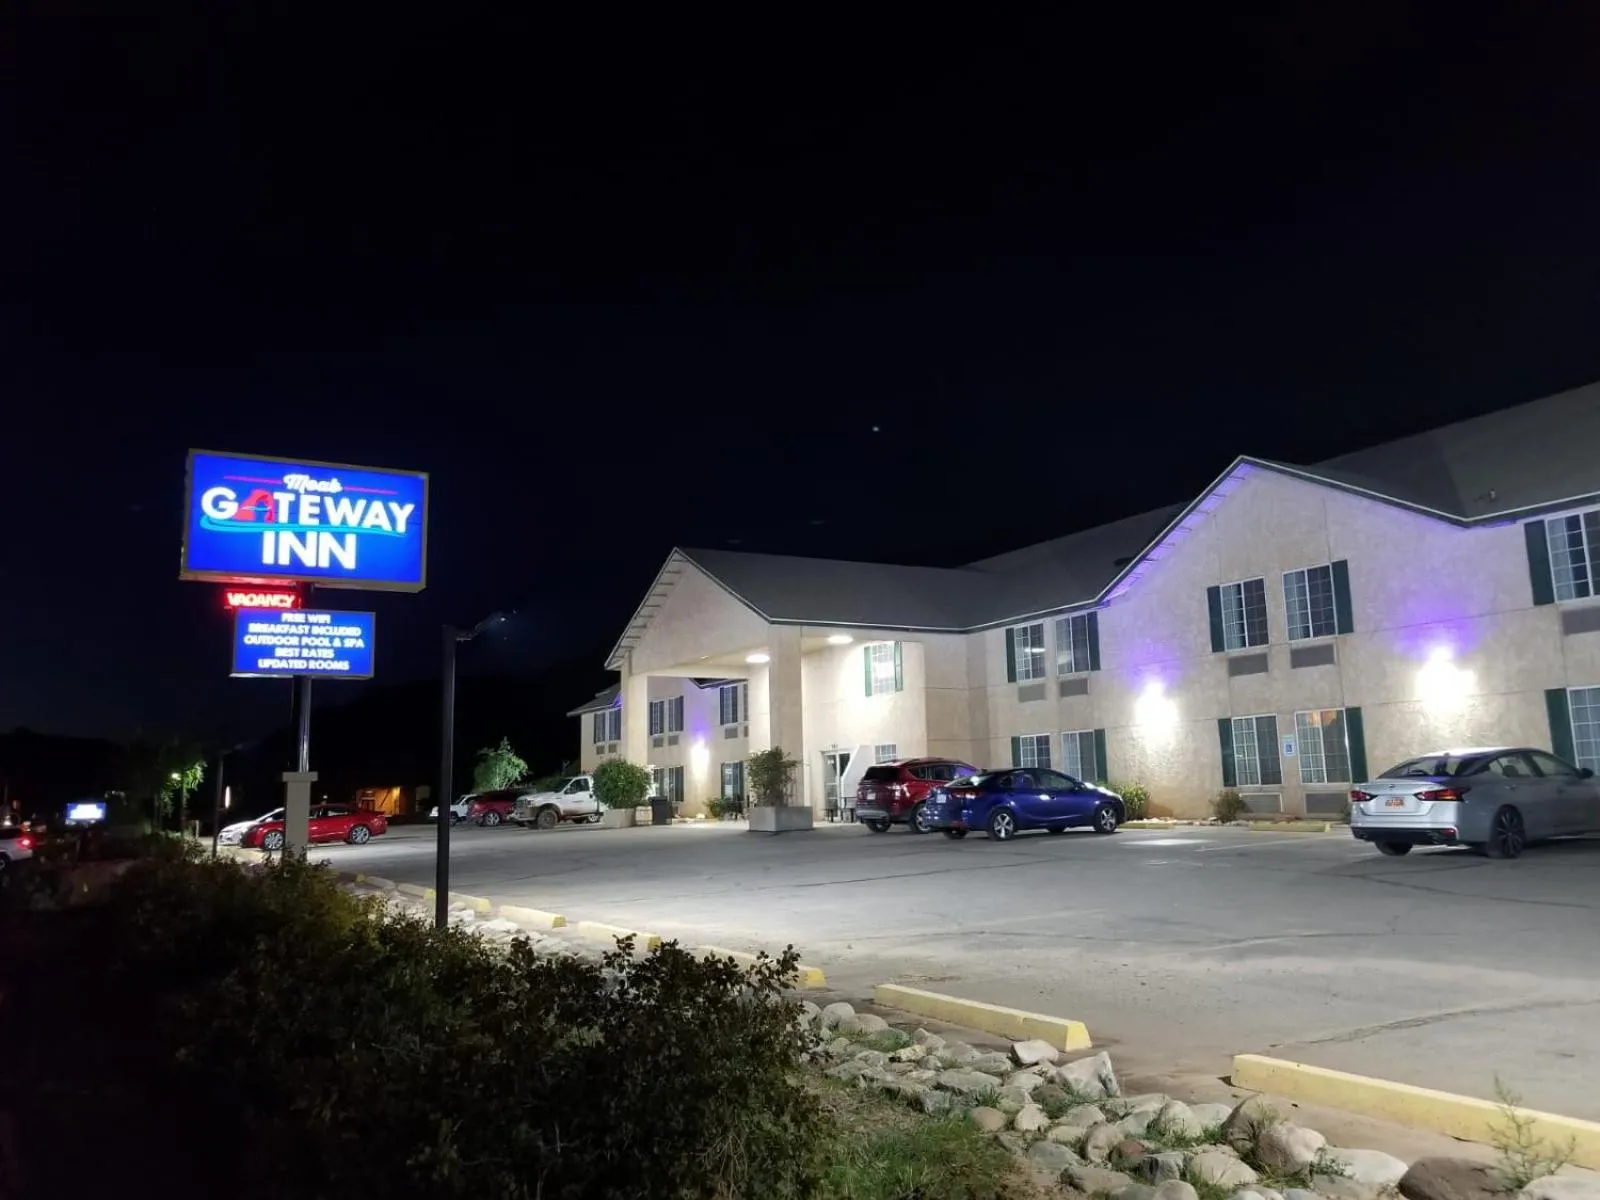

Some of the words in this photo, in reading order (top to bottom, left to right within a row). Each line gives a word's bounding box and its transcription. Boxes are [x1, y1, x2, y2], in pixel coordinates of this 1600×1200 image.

[283, 474, 343, 493] Moab
[201, 486, 415, 533] GATEWAY
[262, 530, 357, 569] INN
[227, 592, 296, 608] VACANCY
[281, 612, 306, 623] FREE
[248, 623, 310, 634] BREAKFAST
[311, 625, 361, 636] INCLUDED
[244, 634, 299, 646] OUTDOOR
[301, 636, 331, 647] POOL
[332, 637, 341, 648] &
[343, 638, 365, 648] SPA
[275, 647, 300, 657] BEST
[301, 648, 335, 659] RATES
[258, 658, 307, 669] UPDATED
[308, 660, 350, 671] ROOMS
